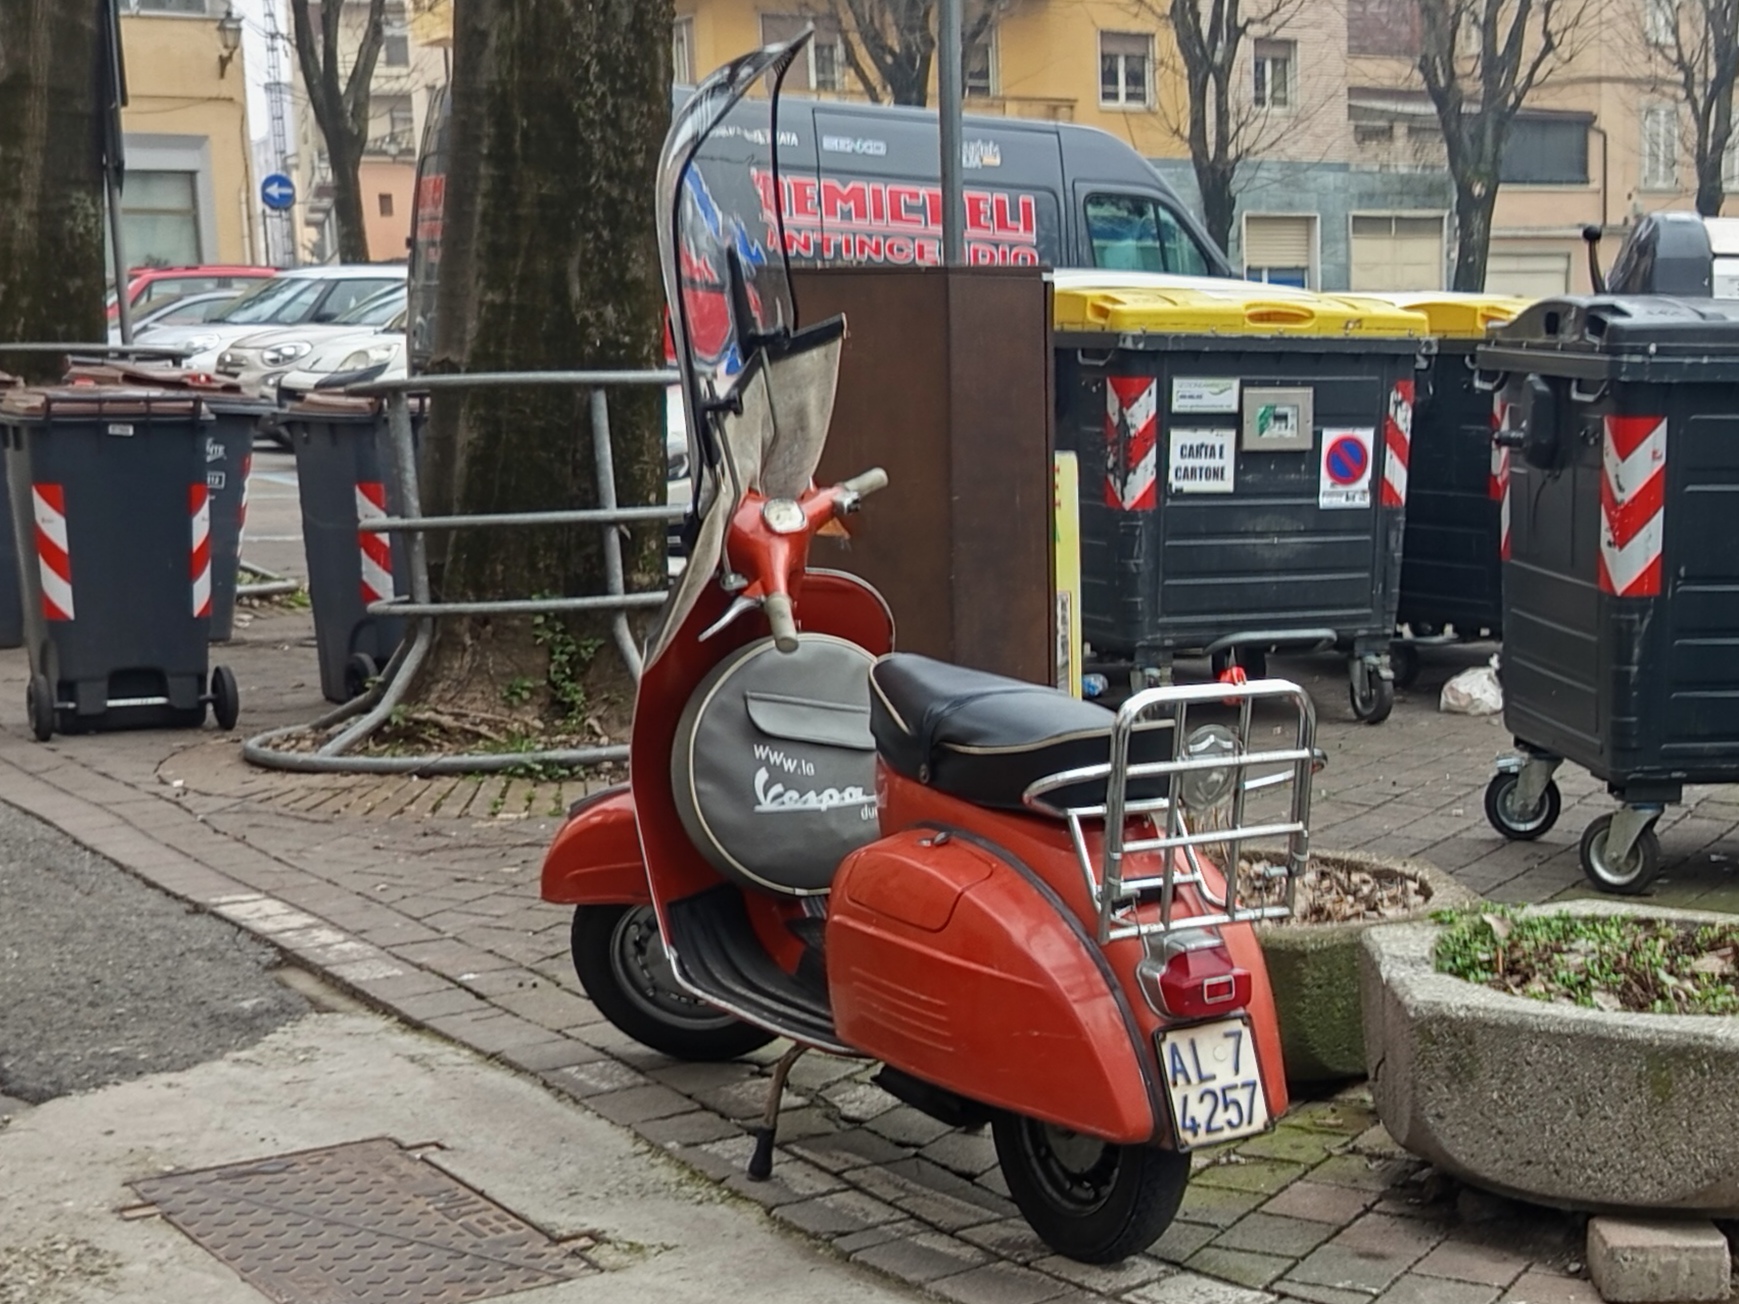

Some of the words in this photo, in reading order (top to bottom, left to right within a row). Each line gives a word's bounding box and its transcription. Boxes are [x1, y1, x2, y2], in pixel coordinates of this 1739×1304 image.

[767, 228, 1039, 267] ANTINCEDIO
[1174, 465, 1226, 481] CARTONE
[1180, 443, 1216, 460] CARTA
[754, 766, 877, 813] Vespa
[1169, 1037, 1217, 1088] AL
[1223, 1029, 1243, 1077] 7
[1180, 1079, 1257, 1138] 4257
